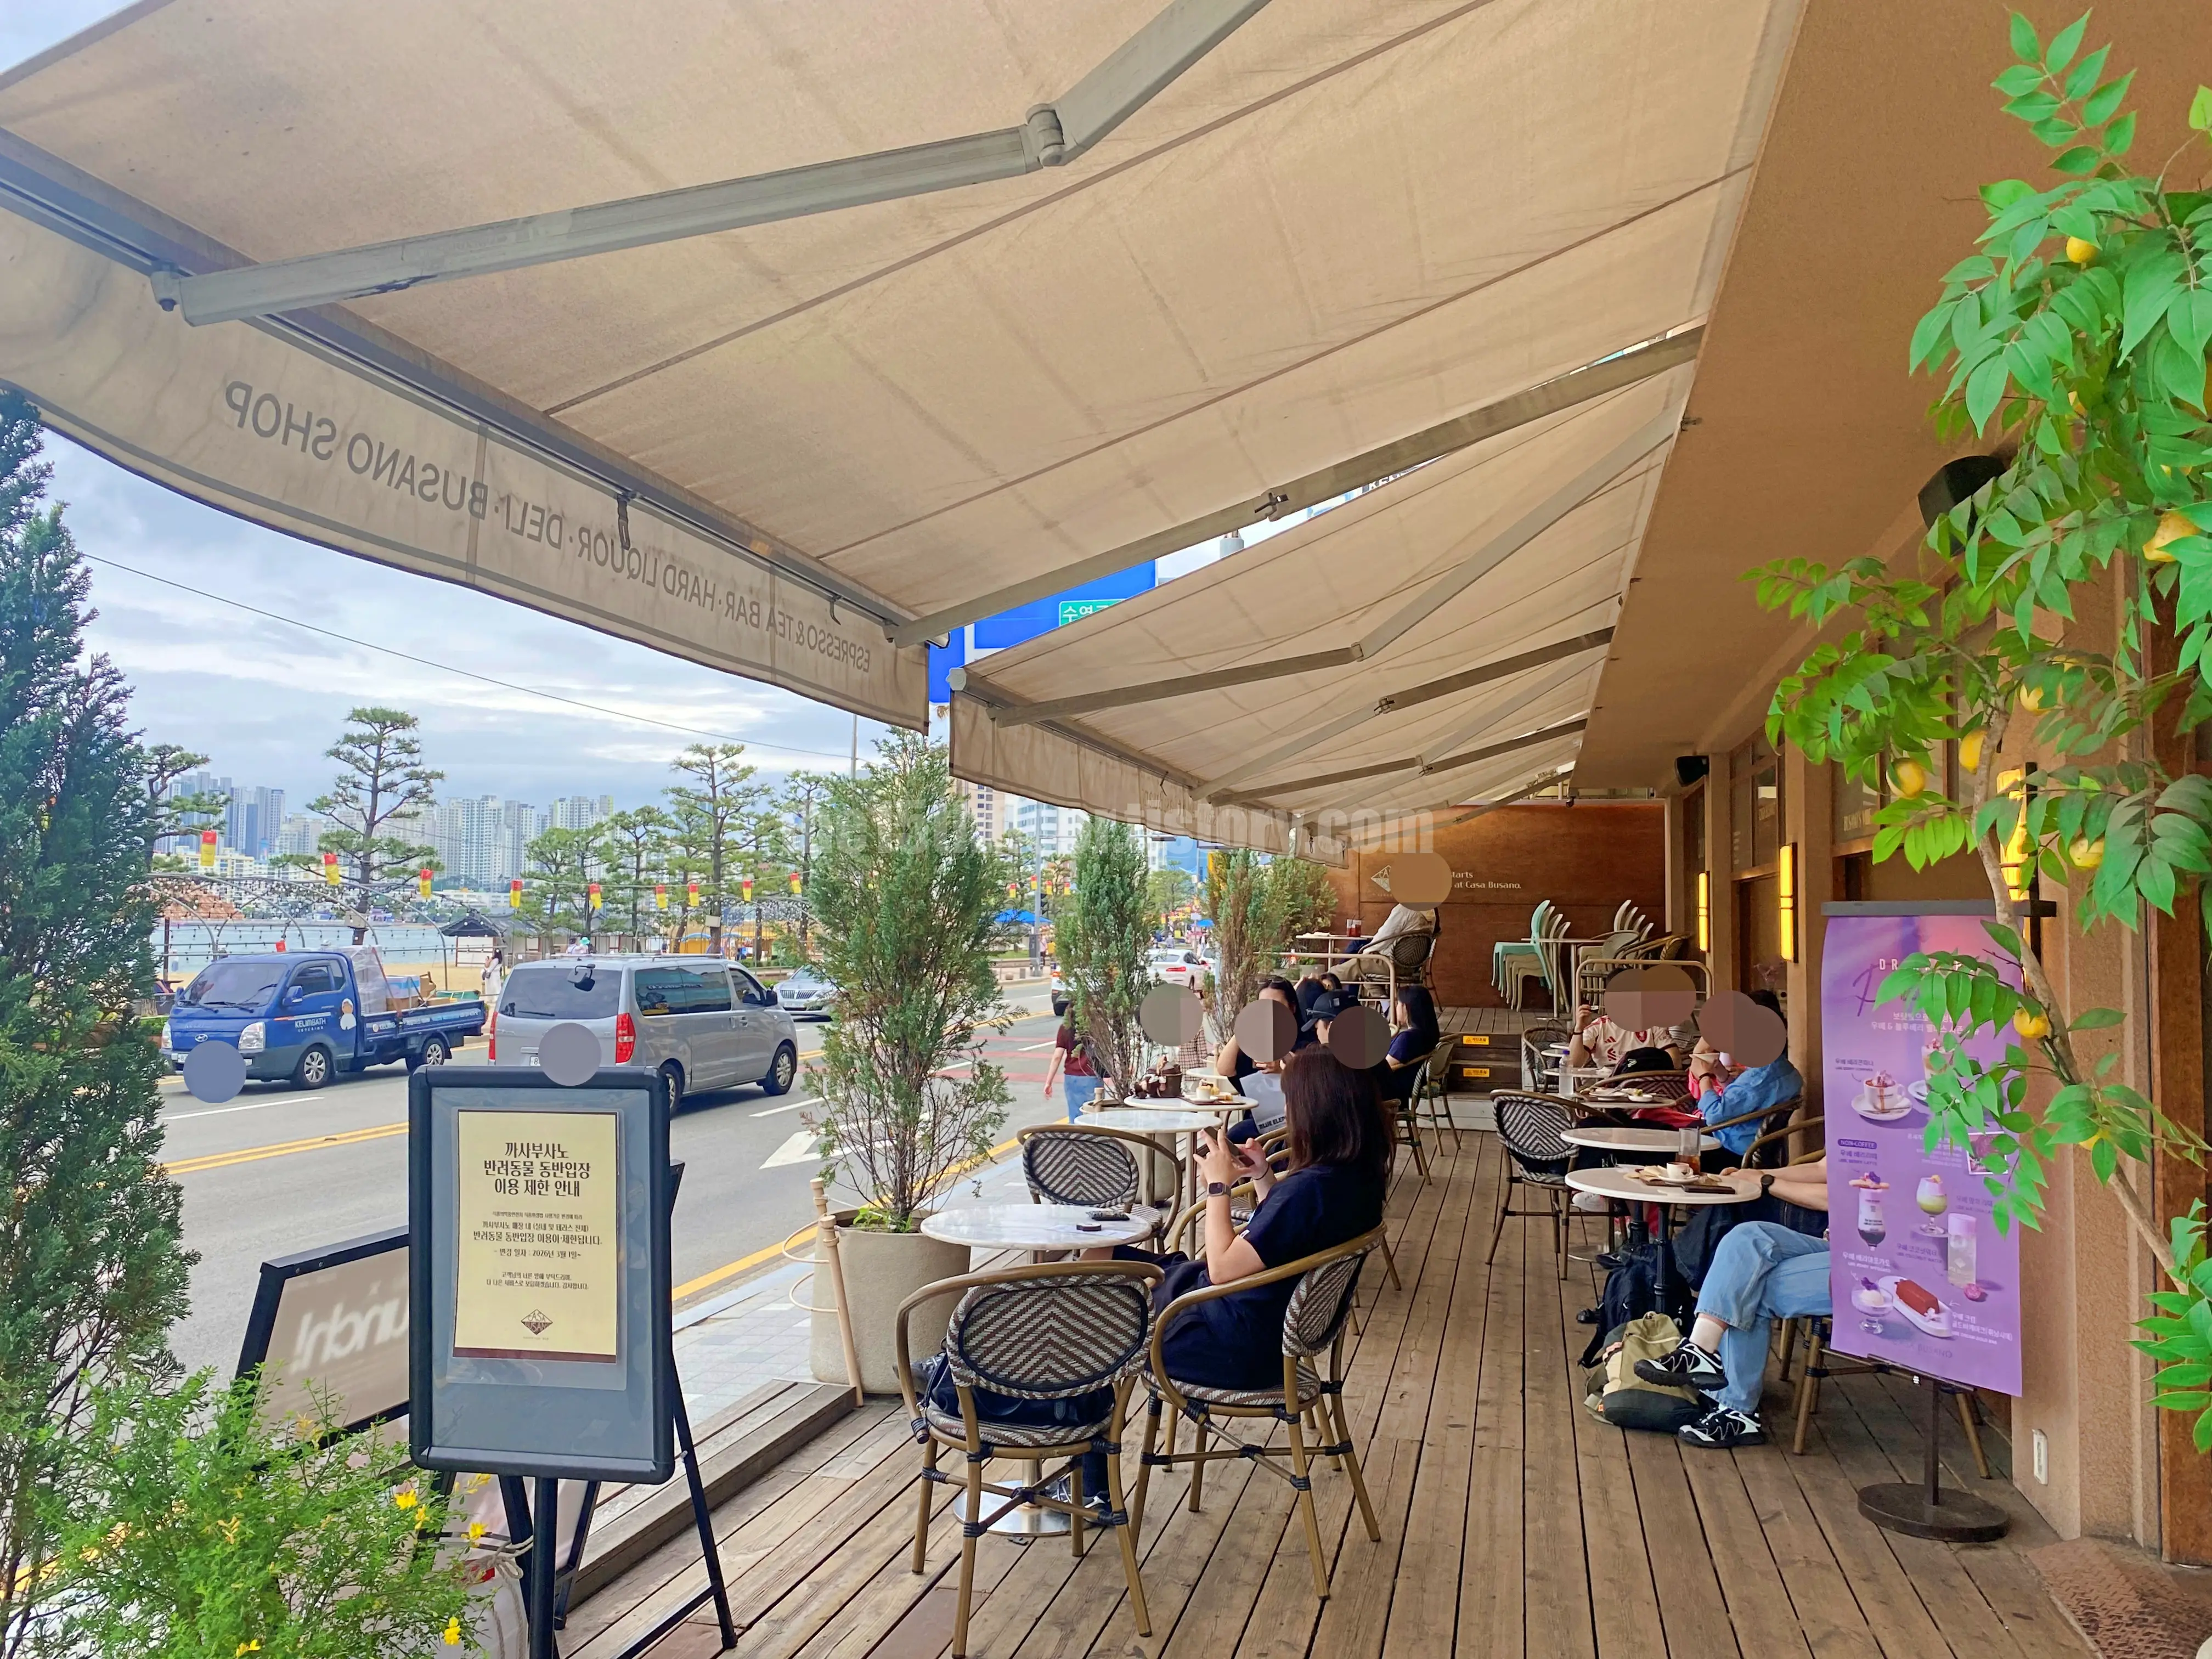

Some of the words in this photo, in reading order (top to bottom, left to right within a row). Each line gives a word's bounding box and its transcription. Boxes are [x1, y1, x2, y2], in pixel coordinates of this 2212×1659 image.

[1488, 881, 1521, 889] Busano.
[505, 1142, 569, 1159] 까사부사노
[484, 1160, 534, 1177] 반려동물
[539, 1161, 591, 1179] 동반입장
[495, 1178, 520, 1195] 이용
[524, 1180, 550, 1196] 제한
[555, 1180, 580, 1197] 안내
[482, 1221, 510, 1229] 까사부사노
[473, 1231, 503, 1242] 반려동물
[505, 1232, 534, 1243] 동반입장
[537, 1233, 560, 1244] 이용이
[500, 1249, 512, 1257] 변경
[533, 1250, 554, 1259] 2026년
